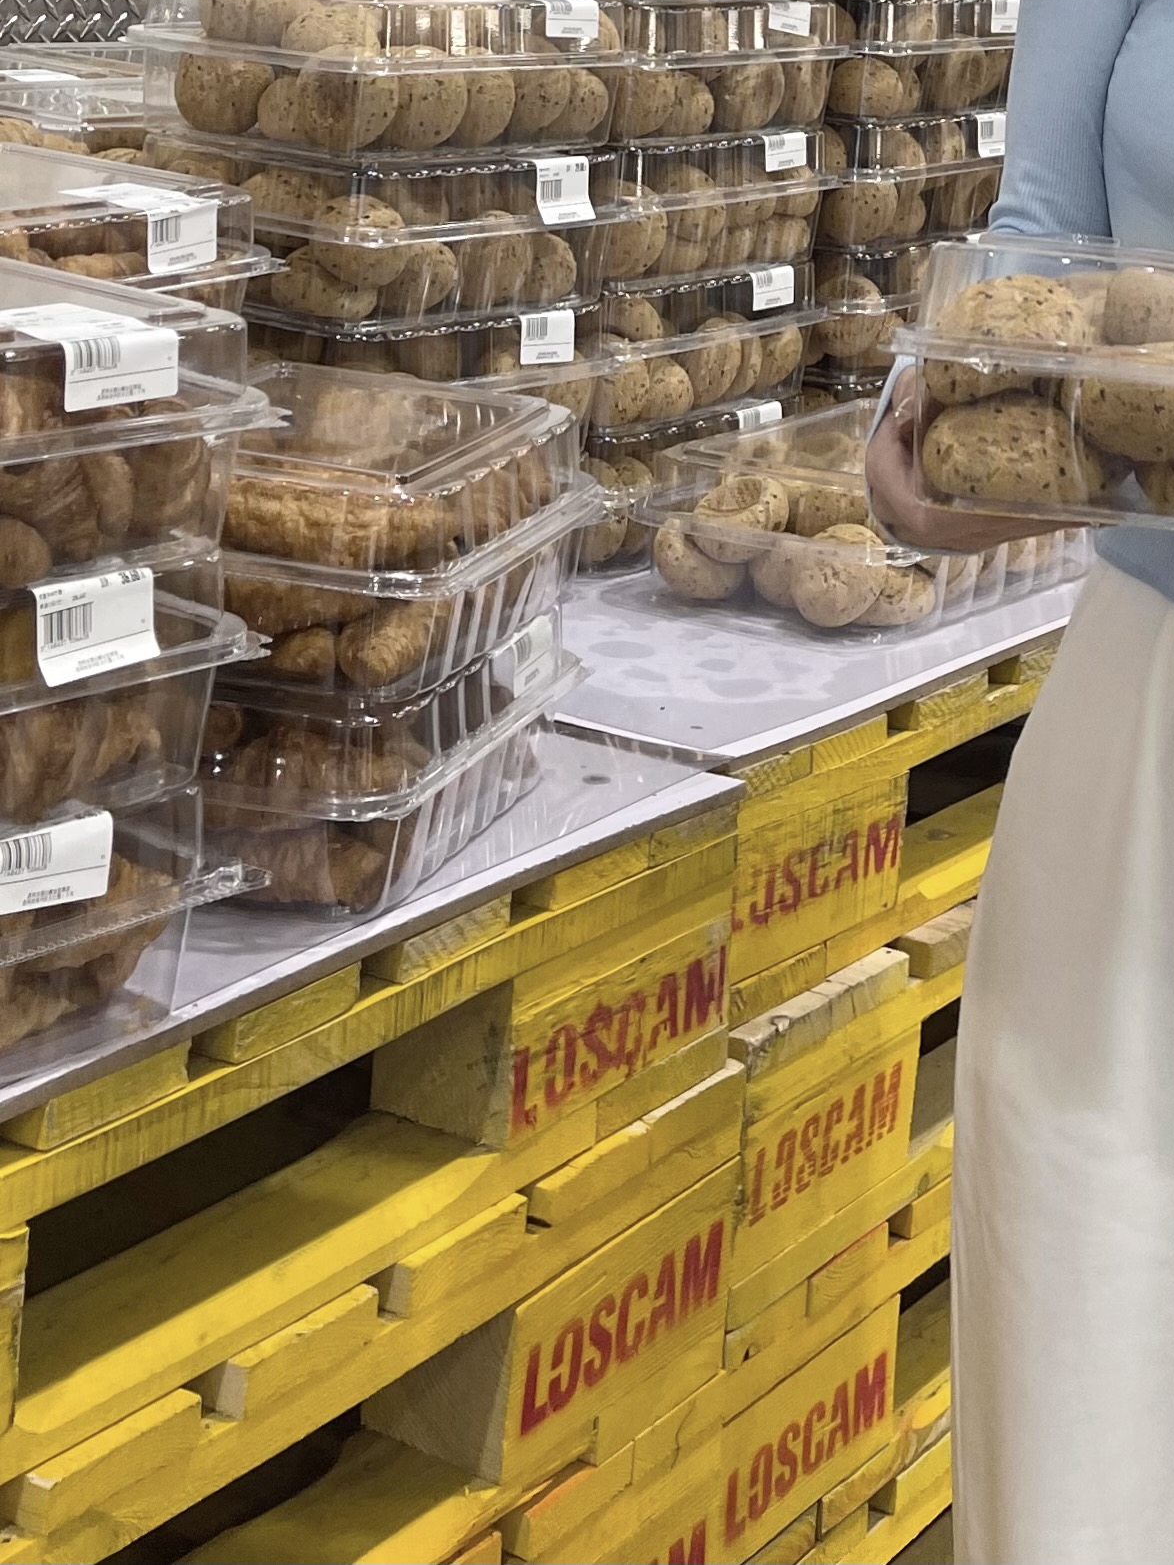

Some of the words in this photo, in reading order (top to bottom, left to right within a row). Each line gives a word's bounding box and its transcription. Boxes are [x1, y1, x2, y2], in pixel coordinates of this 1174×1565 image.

[511, 945, 727, 1134] LOSCAM
[749, 1059, 903, 1228] LOSCAM
[519, 1217, 725, 1437] LOSCAM
[722, 1350, 889, 1546] LOSCAM
